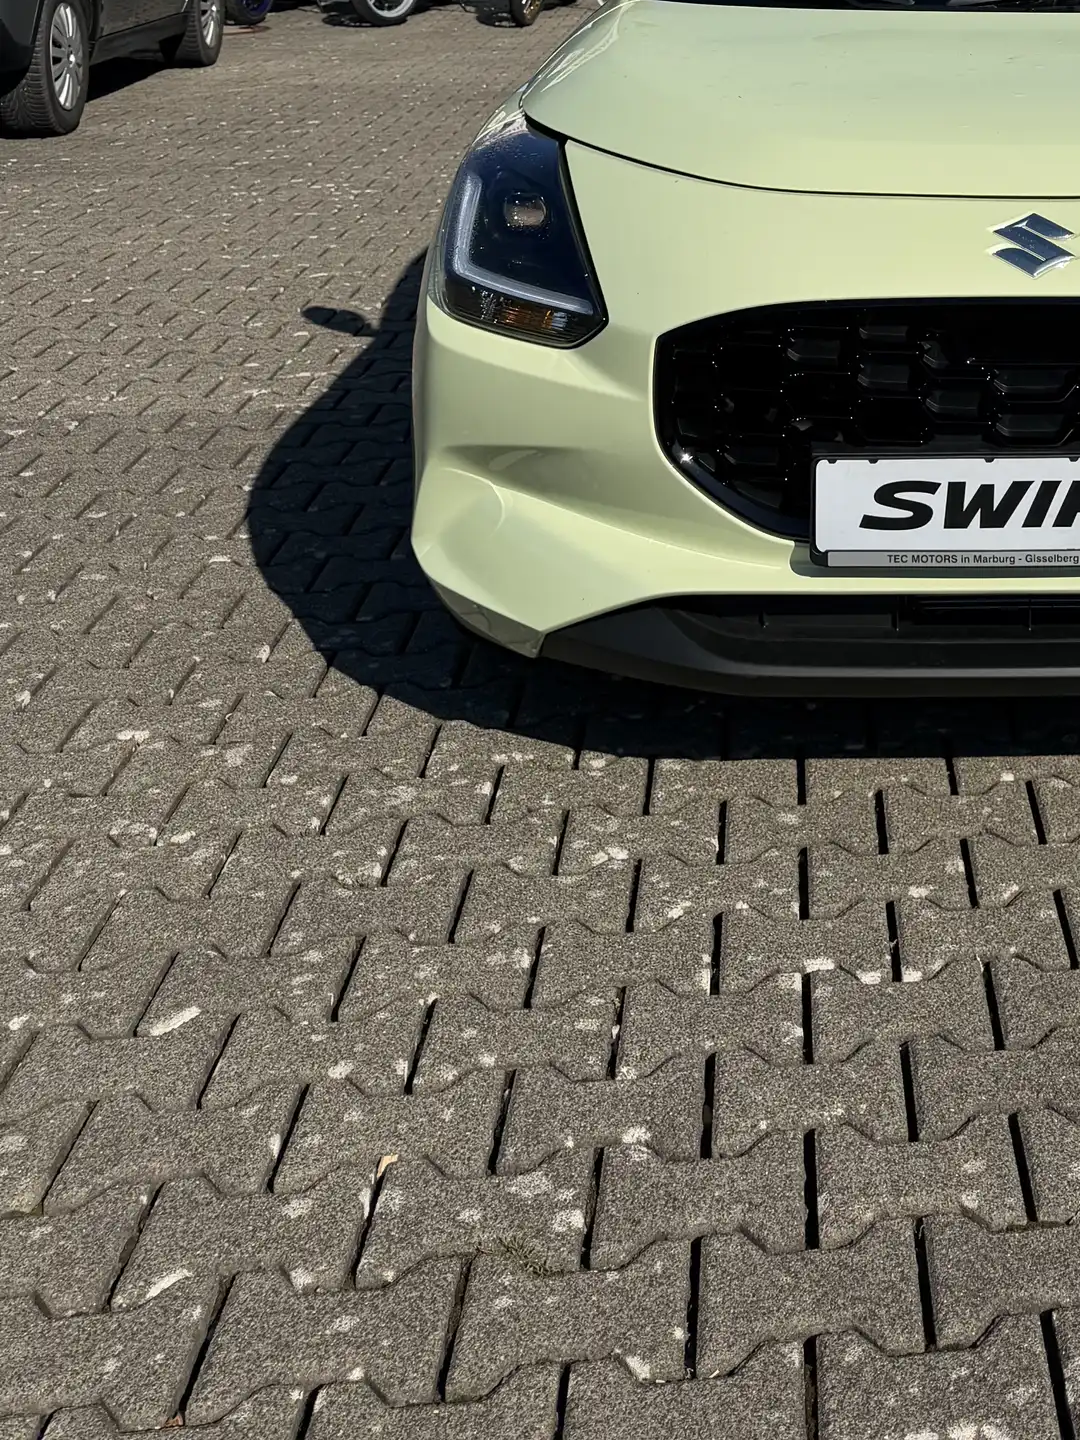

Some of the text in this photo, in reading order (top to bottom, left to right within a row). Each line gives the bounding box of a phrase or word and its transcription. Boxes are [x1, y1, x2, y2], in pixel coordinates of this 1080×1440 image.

[887, 554, 909, 564] TEC
[911, 554, 958, 564] MOTORS
[960, 554, 970, 564] in
[973, 554, 1016, 566] Marburg
[1025, 553, 1080, 566] Gisselberg
